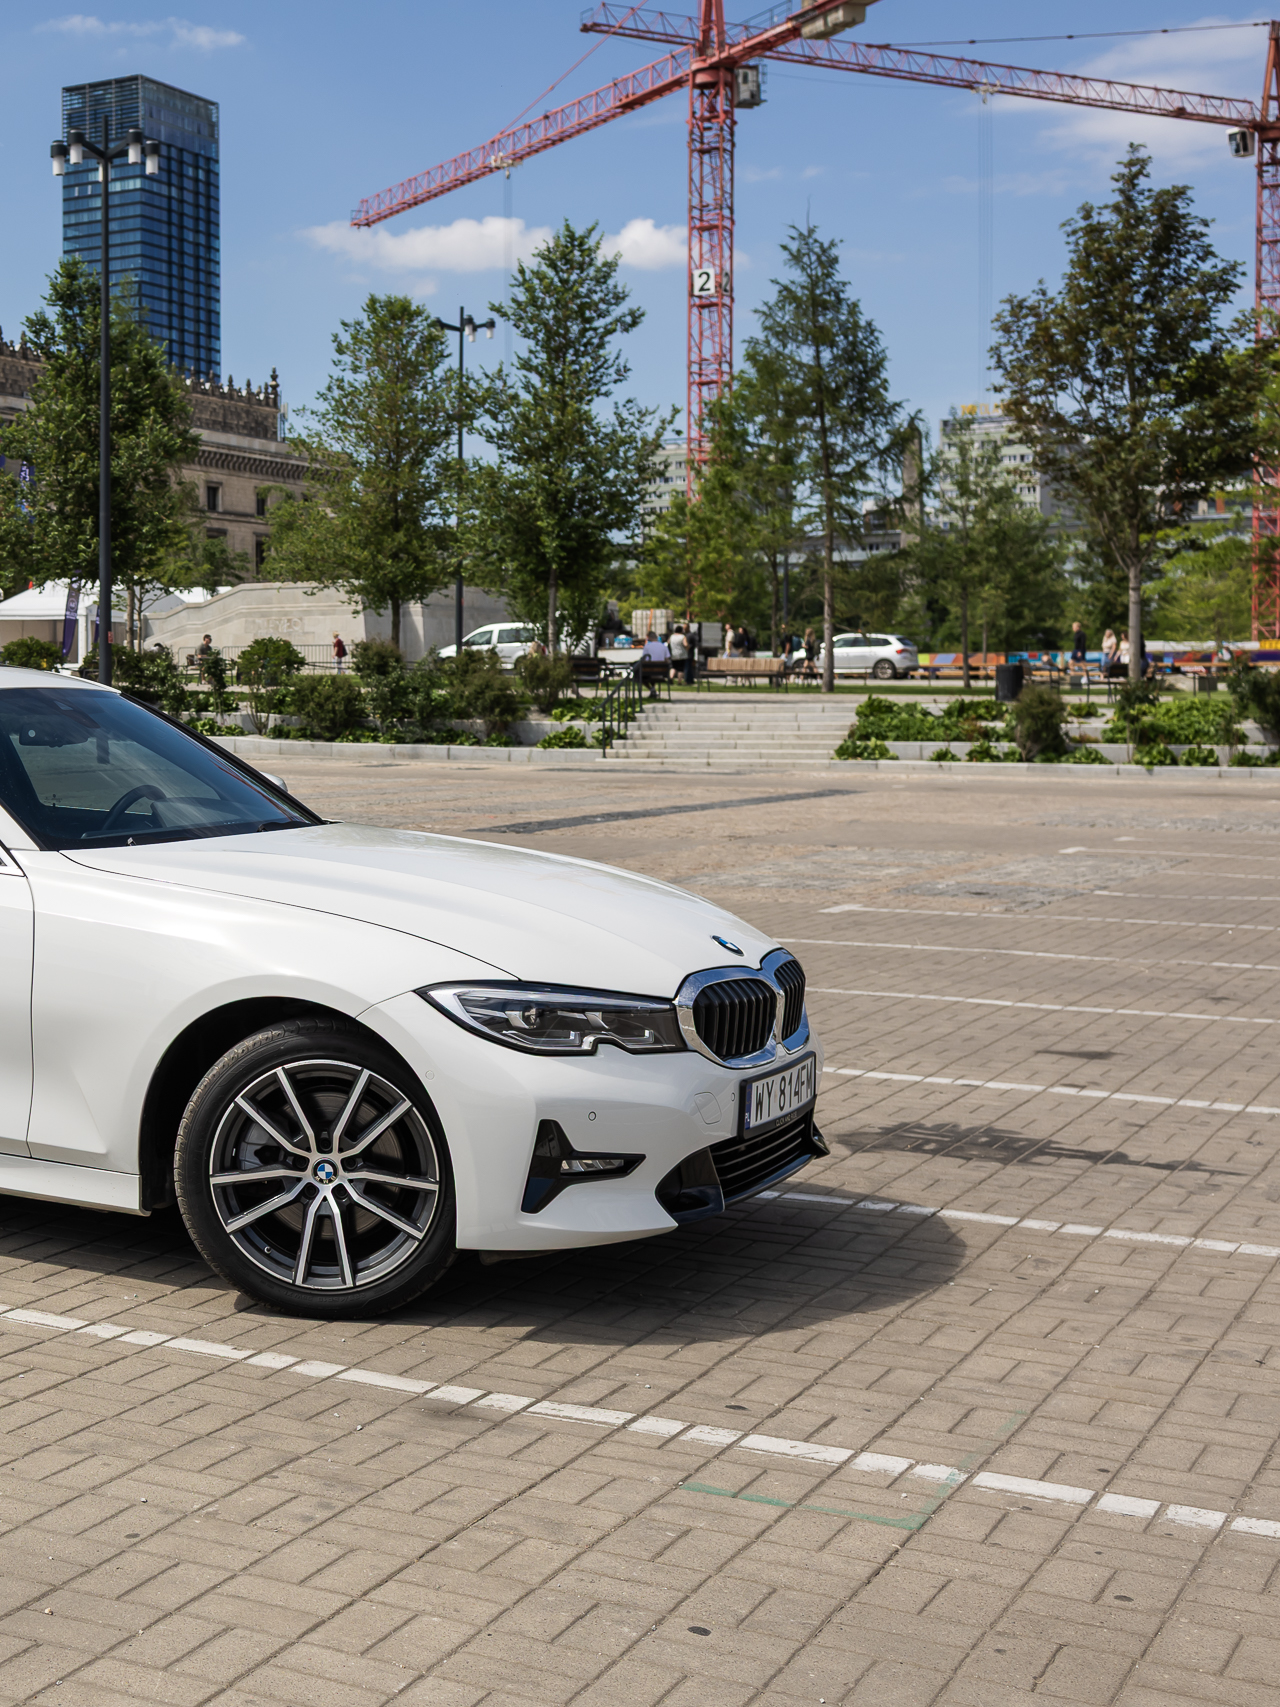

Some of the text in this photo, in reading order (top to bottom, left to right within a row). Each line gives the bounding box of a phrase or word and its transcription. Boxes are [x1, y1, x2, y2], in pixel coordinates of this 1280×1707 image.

[698, 271, 711, 292] 2
[755, 1060, 813, 1122] WY 814FM
